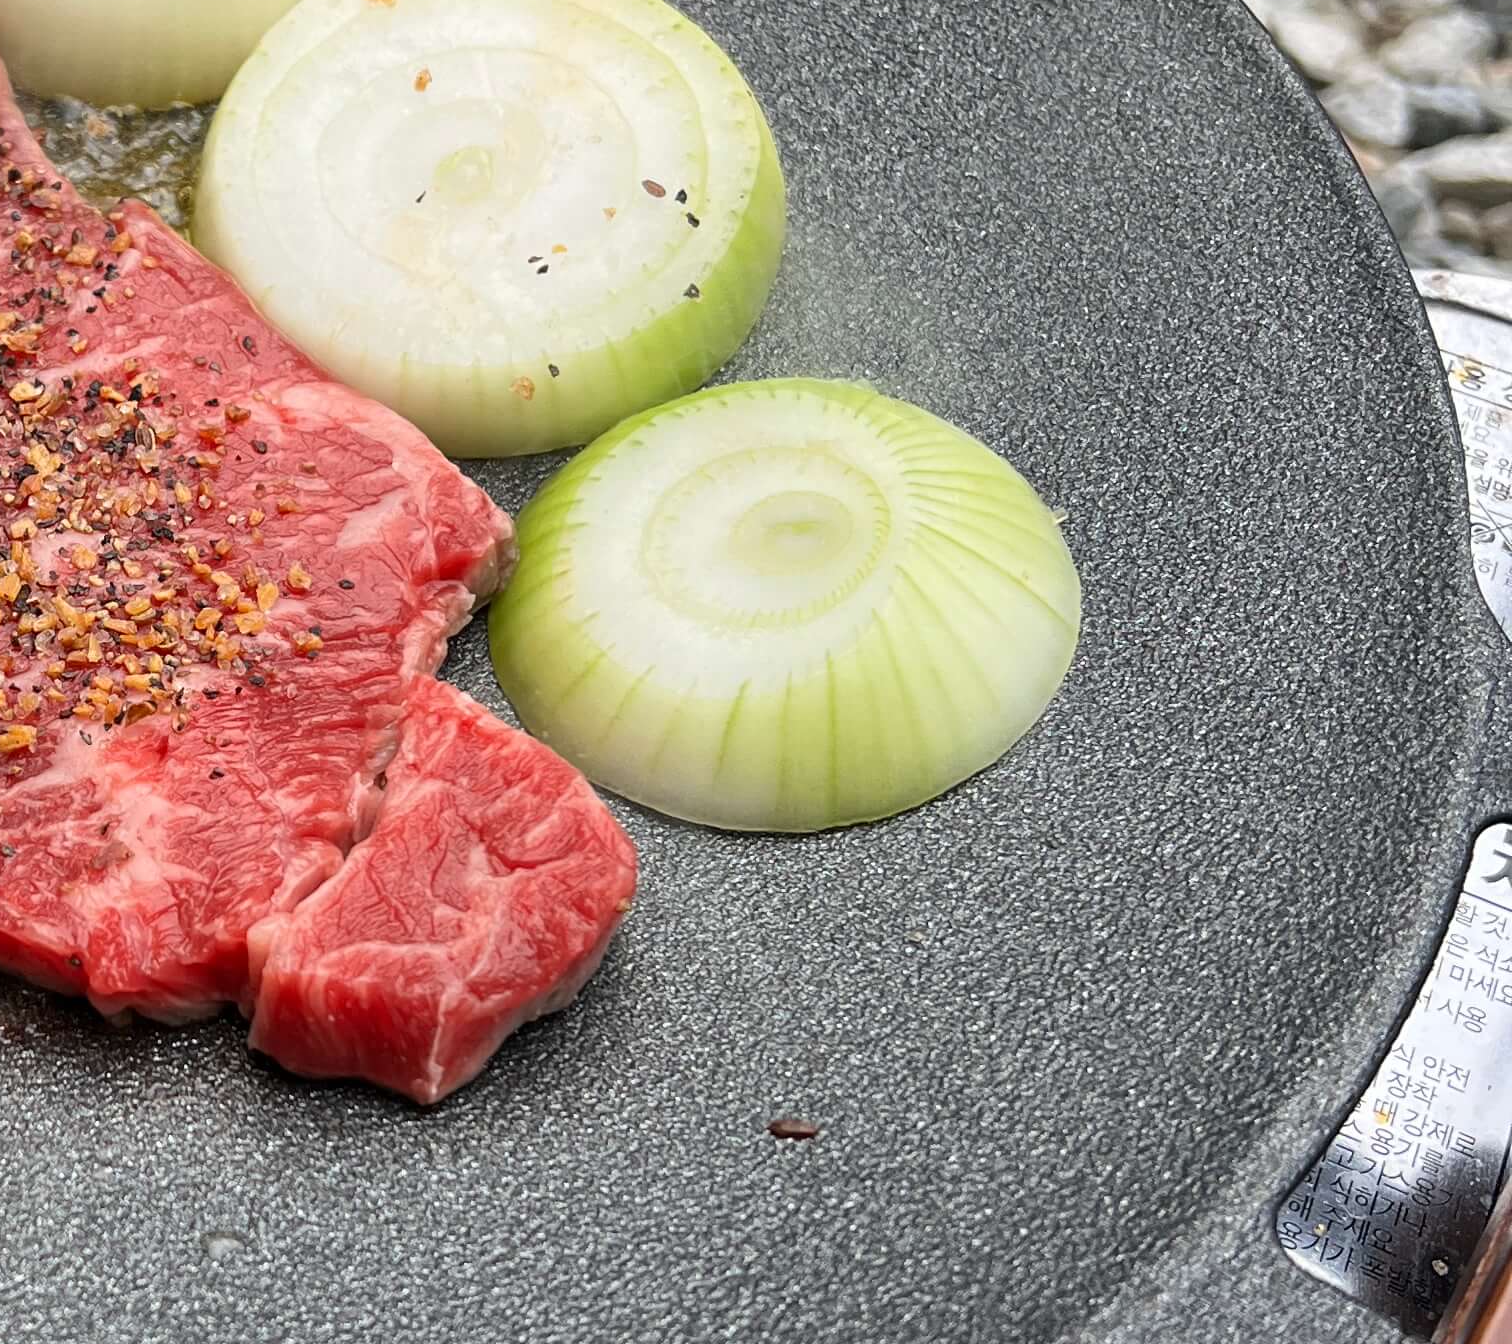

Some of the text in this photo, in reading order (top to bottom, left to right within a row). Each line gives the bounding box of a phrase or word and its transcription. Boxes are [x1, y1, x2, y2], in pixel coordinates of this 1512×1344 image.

[1437, 997, 1488, 1034] 사용
[1387, 1069, 1438, 1110] 장착
[1423, 1055, 1471, 1093] 안전
[1370, 1127, 1445, 1174] 용기를
[1402, 1108, 1477, 1159] 강제로
[1279, 1220, 1355, 1273] 용기가
